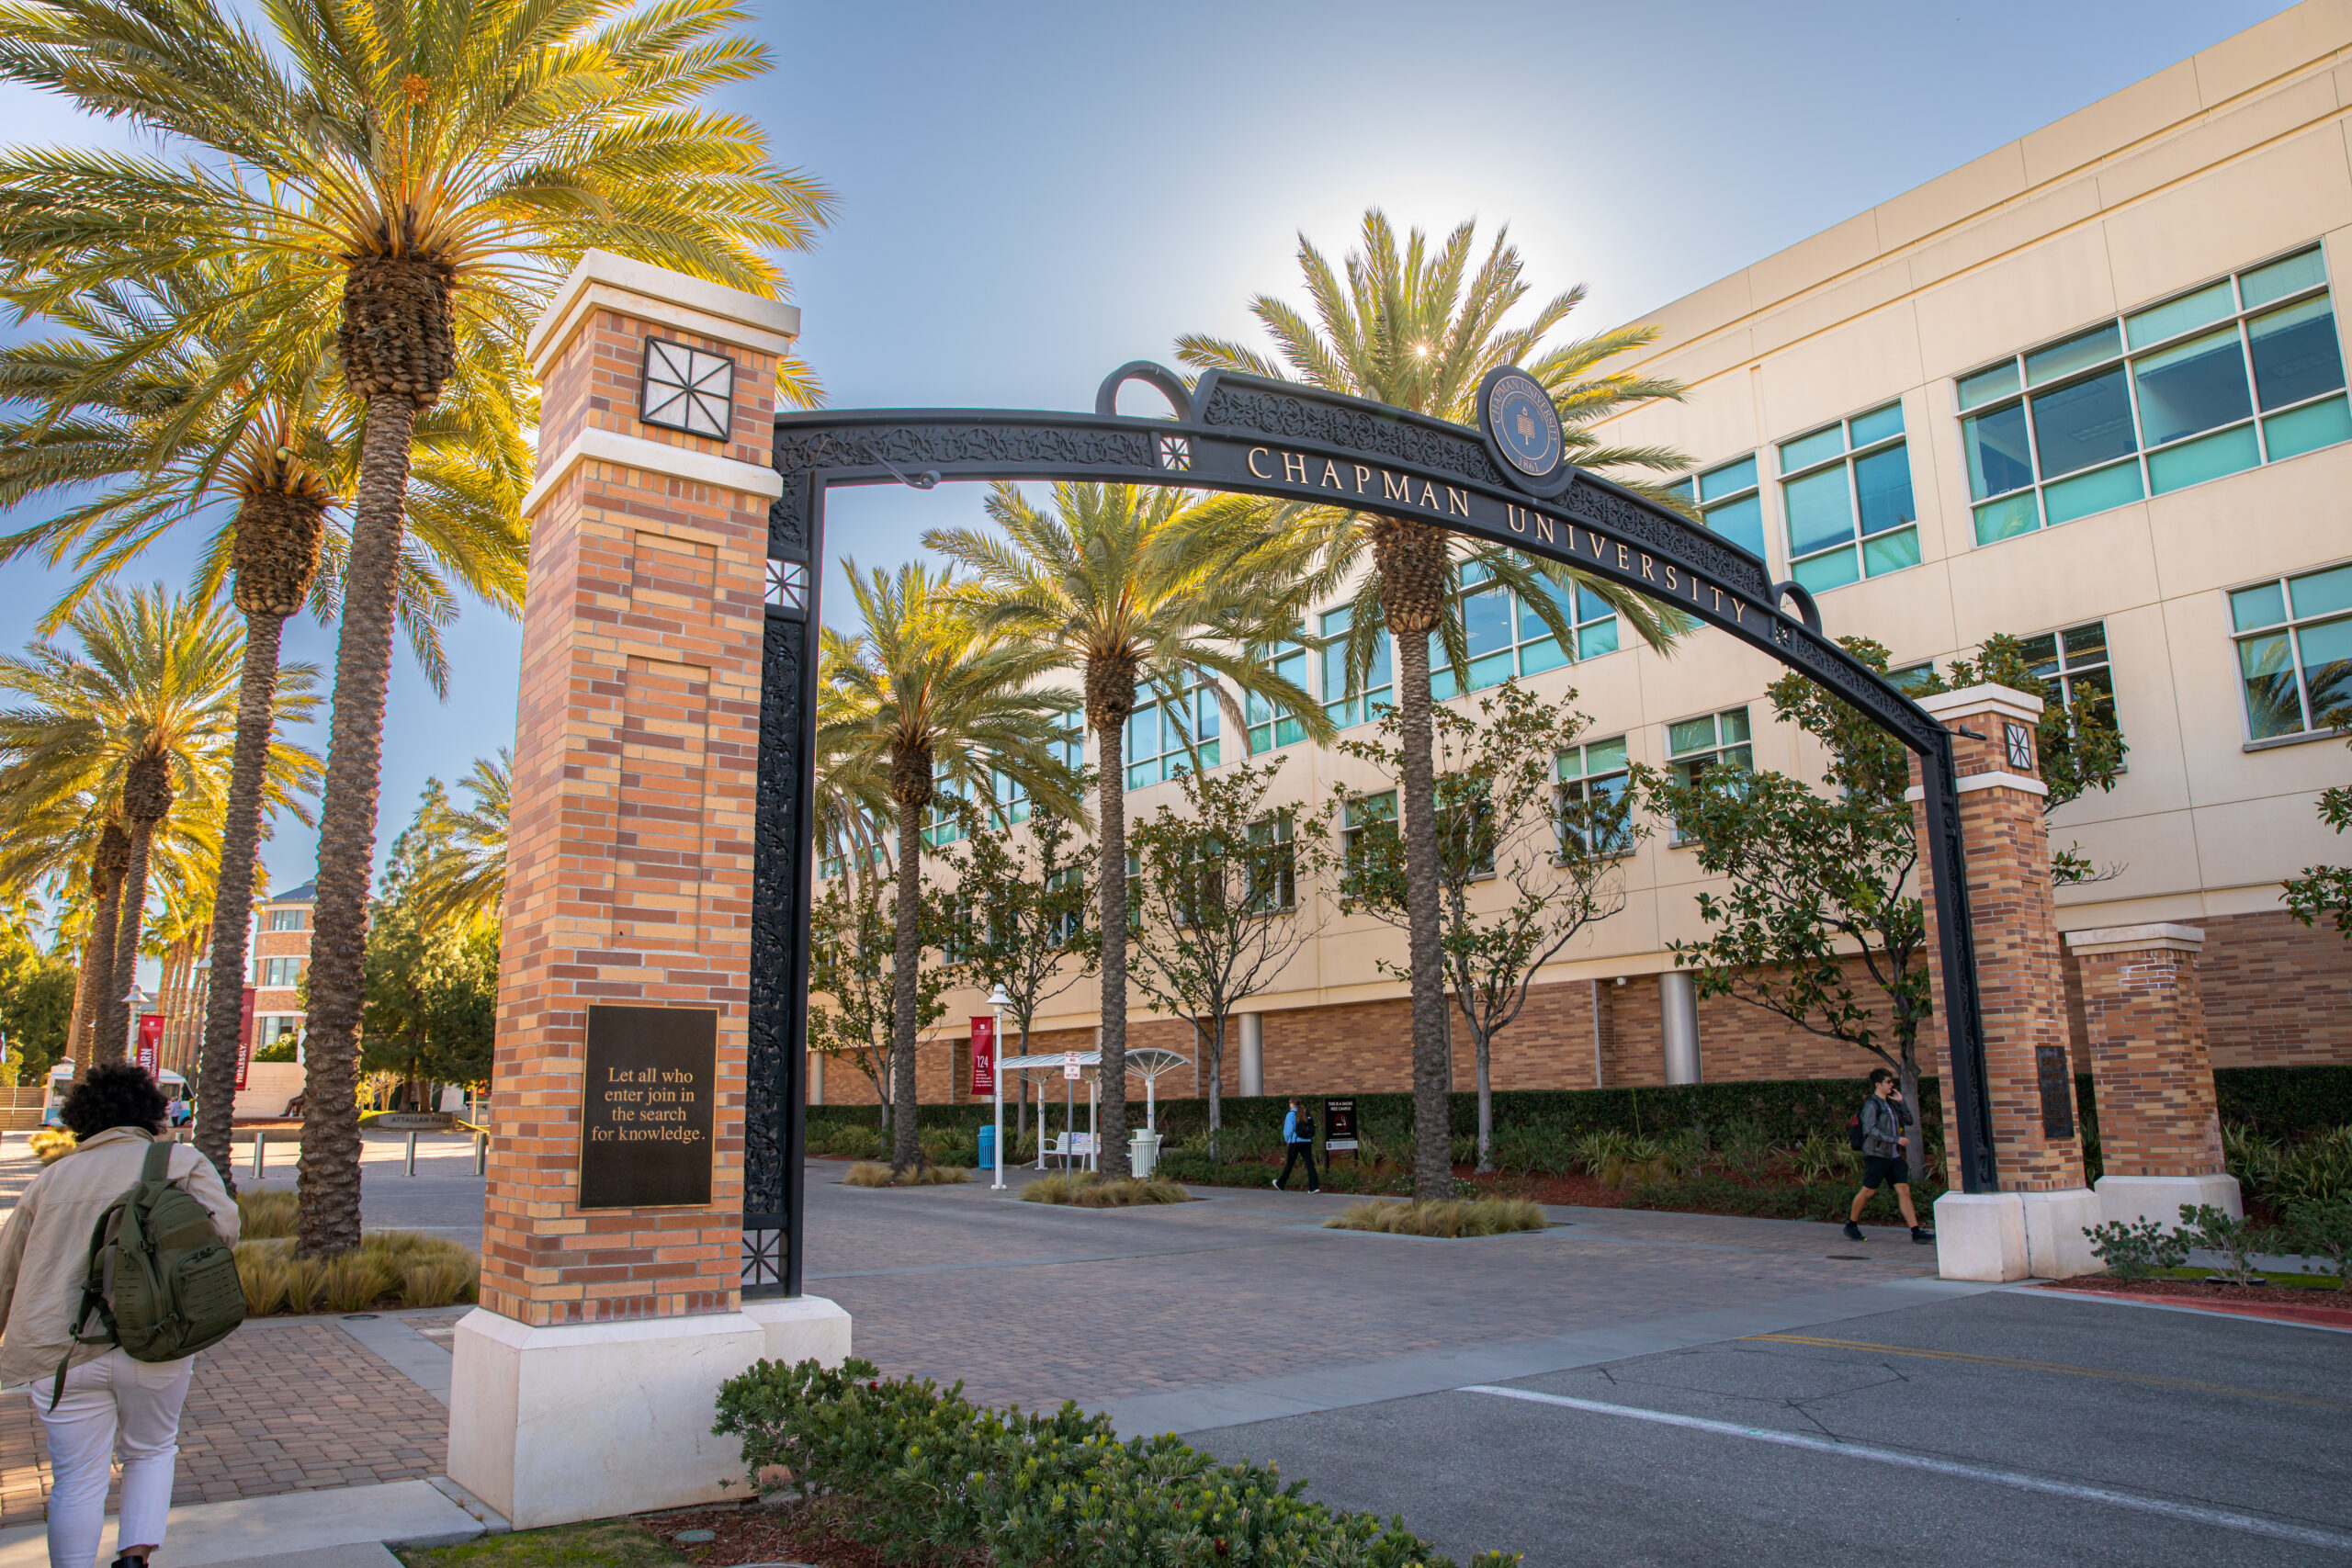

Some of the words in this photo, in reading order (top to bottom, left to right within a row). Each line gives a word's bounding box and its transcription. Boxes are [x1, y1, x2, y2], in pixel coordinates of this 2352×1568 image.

[1491, 378, 1519, 423] CHAPMAN
[1521, 382, 1558, 445] UNIVERSITY
[1518, 457, 1539, 472] 1861
[1248, 446, 1470, 517] CHAPMAN
[1507, 503, 1747, 624] UNIVERSITY
[140, 1048, 153, 1071] ARN
[235, 1043, 248, 1083] TIRELESSLY.
[977, 1055, 989, 1068] 124
[608, 1067, 634, 1082] Let
[639, 1067, 657, 1082] all
[662, 1068, 694, 1083] who
[605, 1089, 643, 1101] enter
[645, 1087, 675, 1105] join
[681, 1087, 695, 1101] in
[612, 1106, 635, 1121] the
[639, 1106, 687, 1121] search
[592, 1126, 615, 1141] for
[618, 1126, 706, 1144] knowledge.
